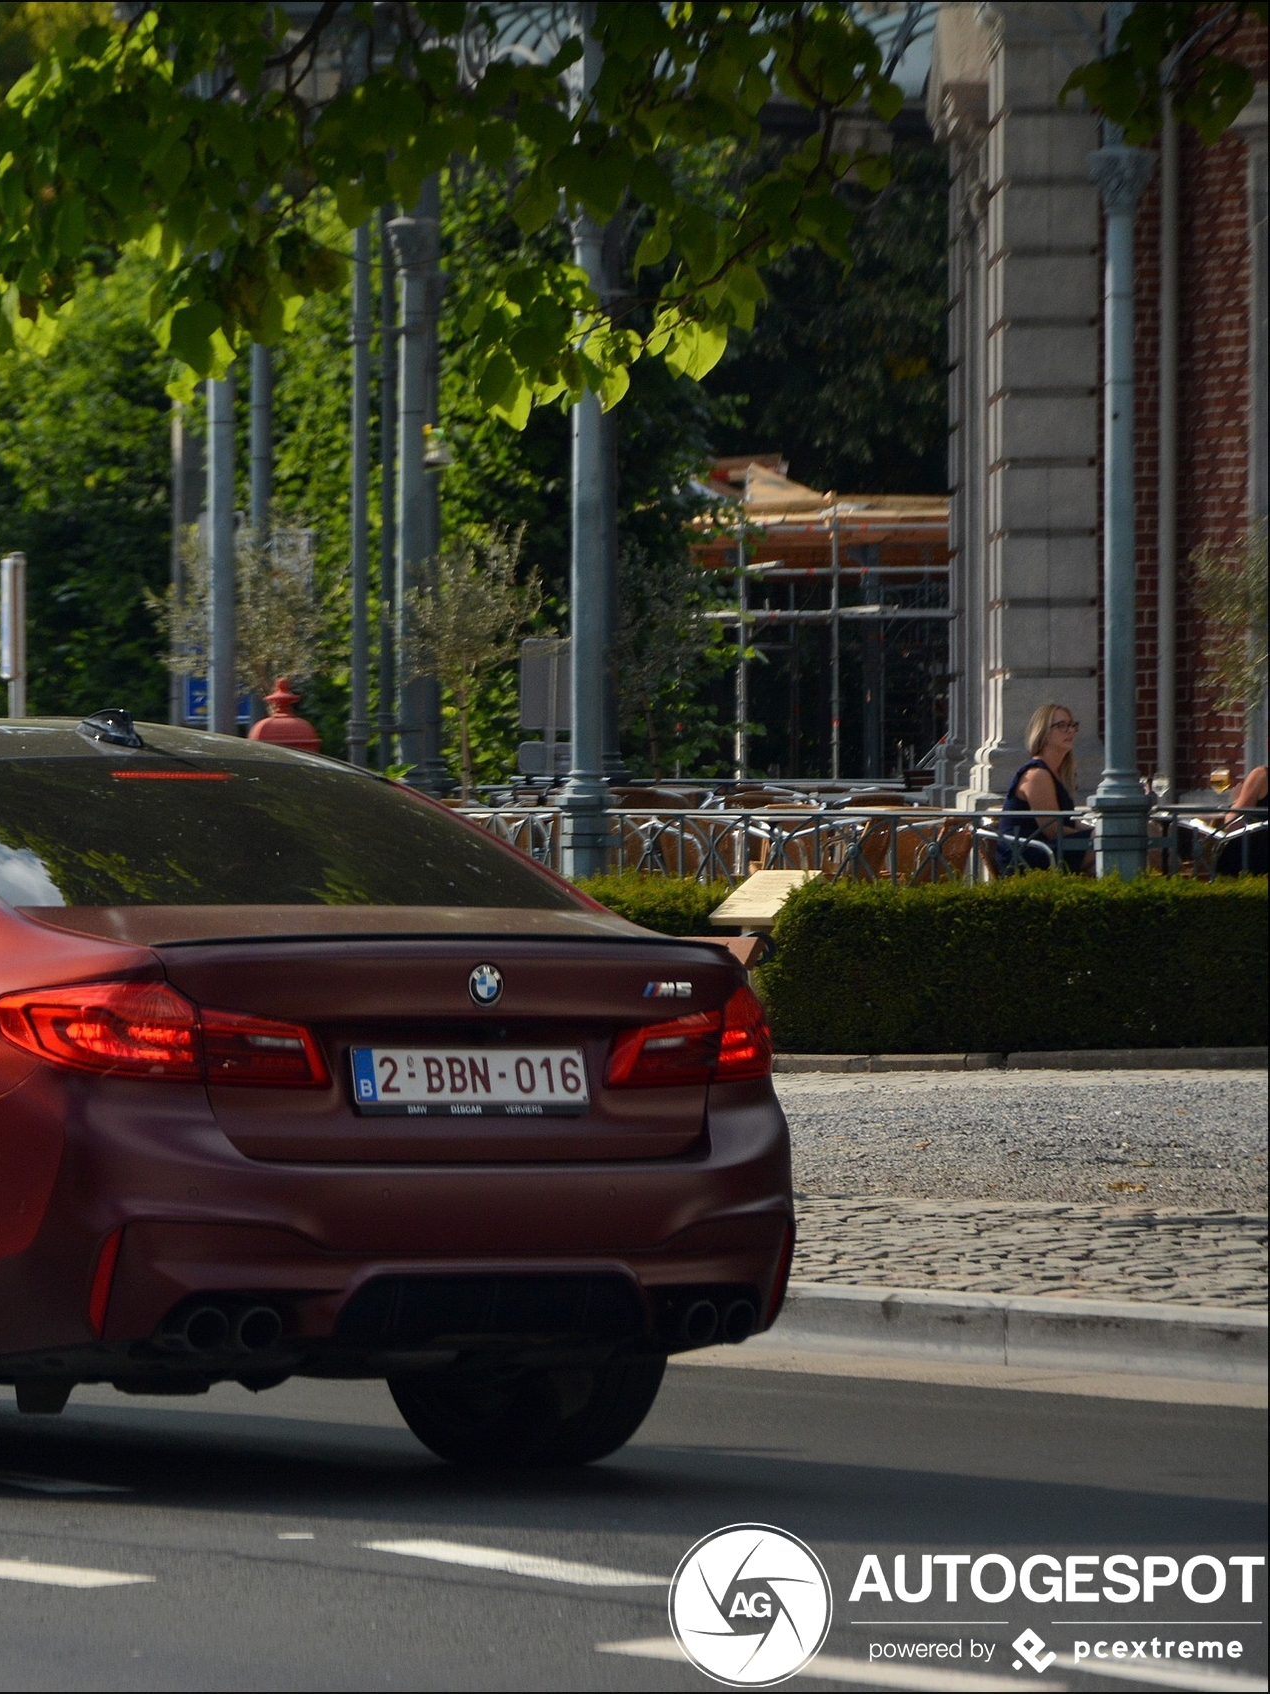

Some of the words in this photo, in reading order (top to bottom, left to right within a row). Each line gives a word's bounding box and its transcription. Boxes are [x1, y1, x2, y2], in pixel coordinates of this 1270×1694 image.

[656, 981, 693, 998] M5
[360, 1079, 373, 1097] B
[407, 1104, 428, 1114] BMW
[505, 1104, 543, 1114] VERVIERS
